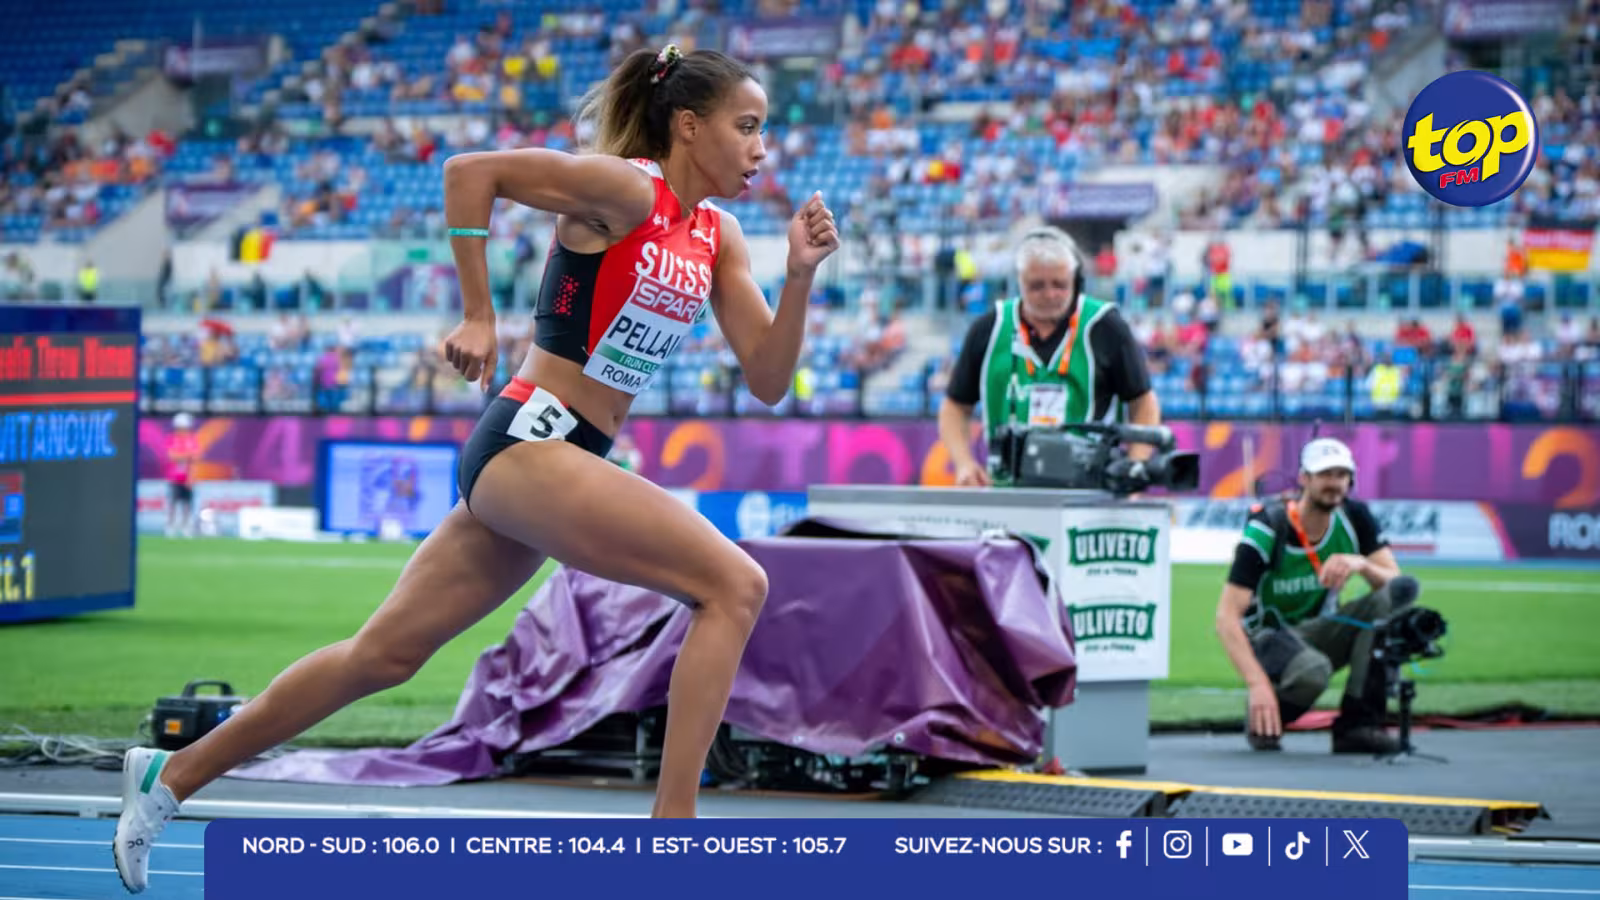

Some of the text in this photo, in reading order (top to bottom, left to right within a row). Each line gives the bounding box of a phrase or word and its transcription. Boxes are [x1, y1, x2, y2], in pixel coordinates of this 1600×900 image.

[635, 282, 700, 320] SPAR
[607, 315, 681, 359] PELLA
[601, 364, 641, 388] ROMA
[530, 404, 562, 439] 5
[1075, 532, 1150, 562] ULIVETO
[1548, 511, 1600, 549] RO
[1073, 608, 1149, 638] ULIVETO
